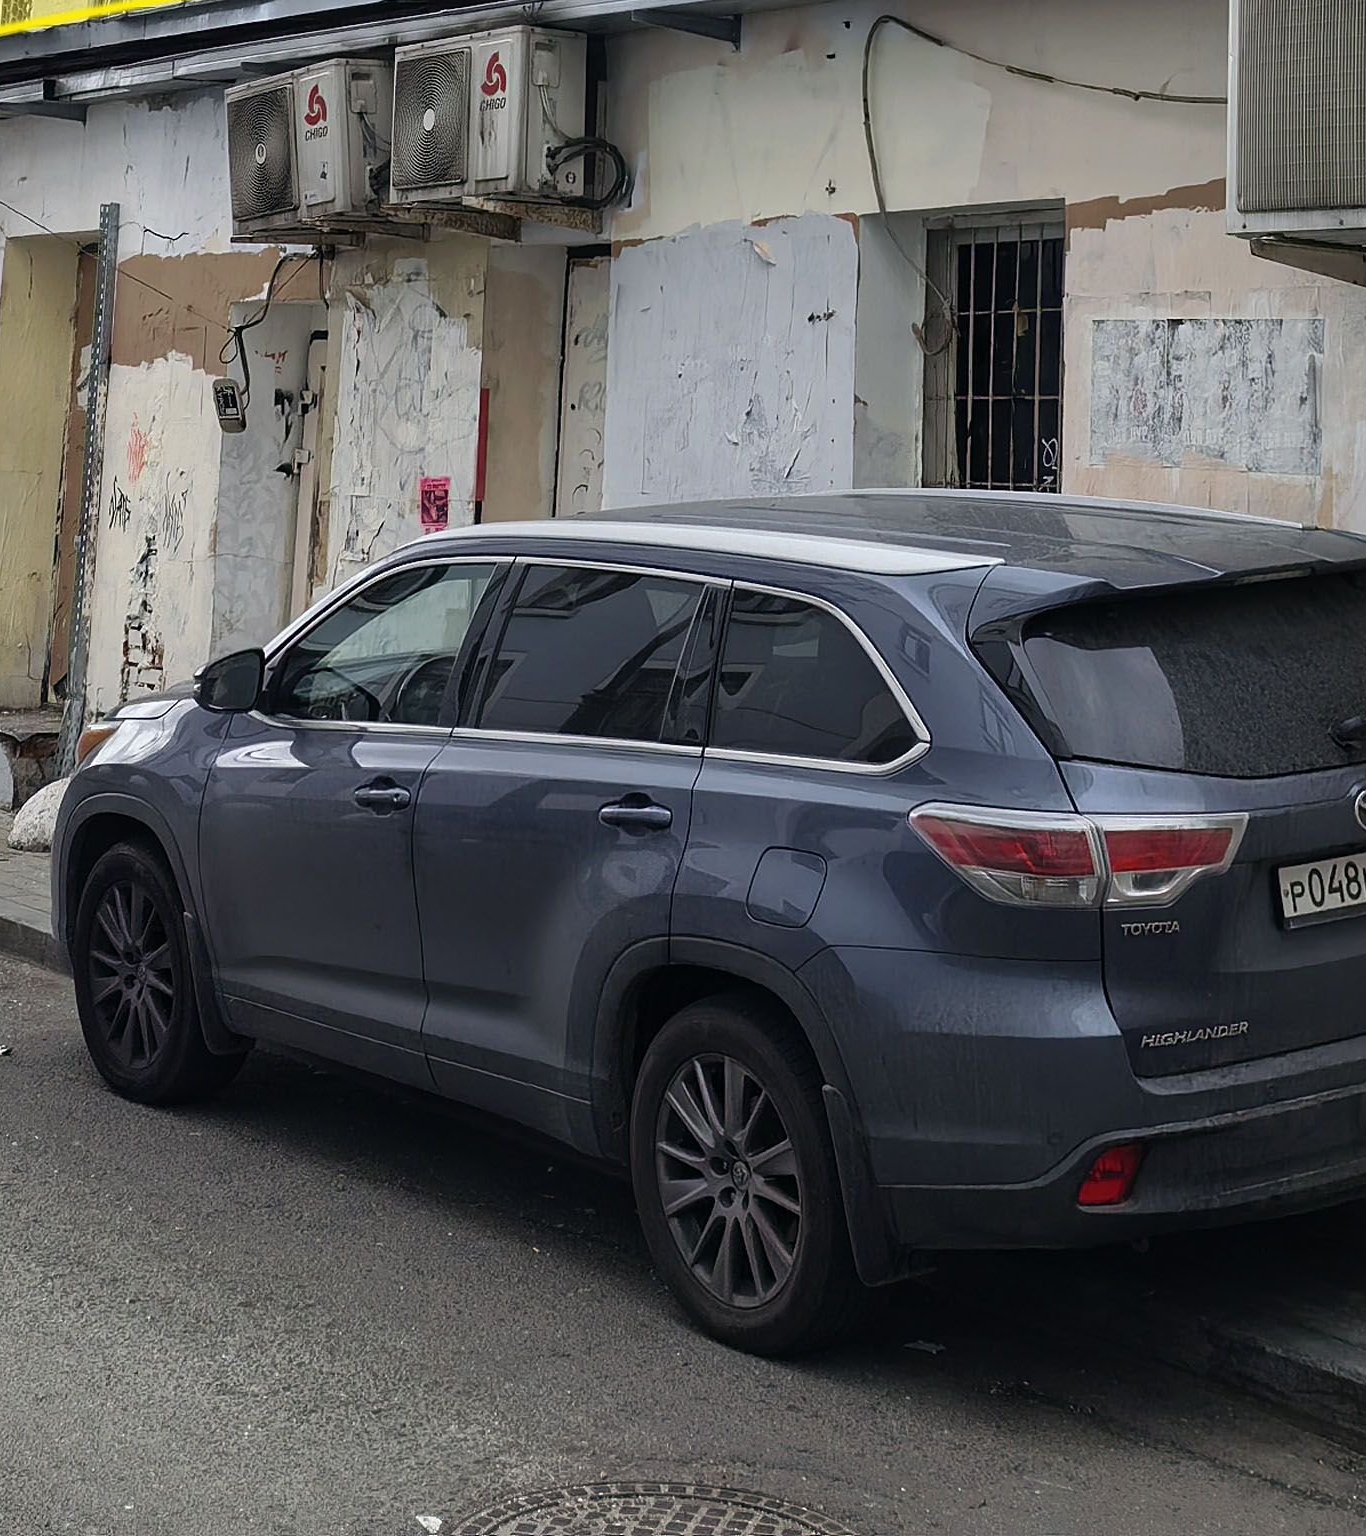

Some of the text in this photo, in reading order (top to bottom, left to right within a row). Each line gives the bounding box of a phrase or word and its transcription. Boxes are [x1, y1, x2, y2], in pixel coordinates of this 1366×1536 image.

[479, 97, 506, 112] CHIGO
[305, 125, 329, 141] CHIGO
[1121, 921, 1180, 936] TOYOTA
[1140, 1021, 1249, 1048] HIGHLANDER
